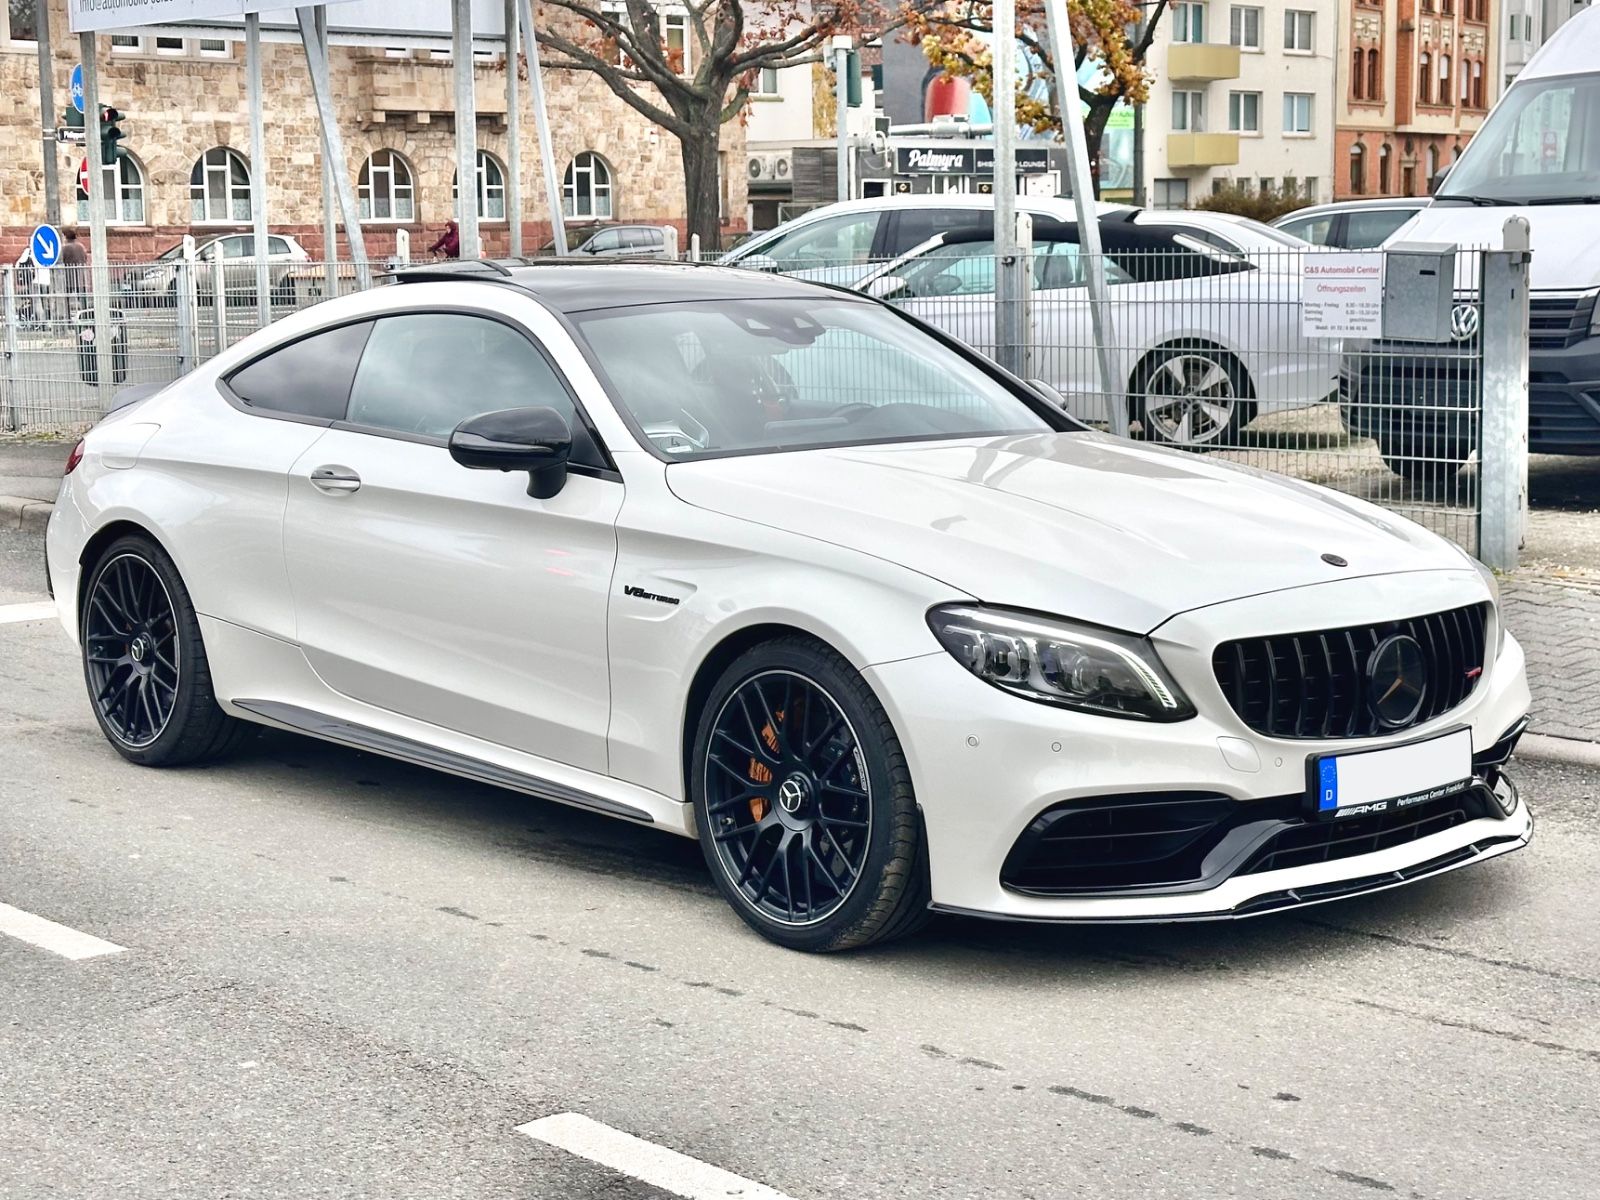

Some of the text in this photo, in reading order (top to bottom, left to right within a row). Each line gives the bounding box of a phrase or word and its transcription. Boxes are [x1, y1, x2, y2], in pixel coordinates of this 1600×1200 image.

[908, 149, 964, 171] Palmyra
[1304, 266, 1380, 274] C&S Automobil Center
[1316, 284, 1367, 294] Öffnungszeiten
[1325, 789, 1333, 801] D
[1353, 802, 1387, 815] AMG
[1397, 794, 1429, 807] Performance
[1429, 789, 1445, 799] Center
